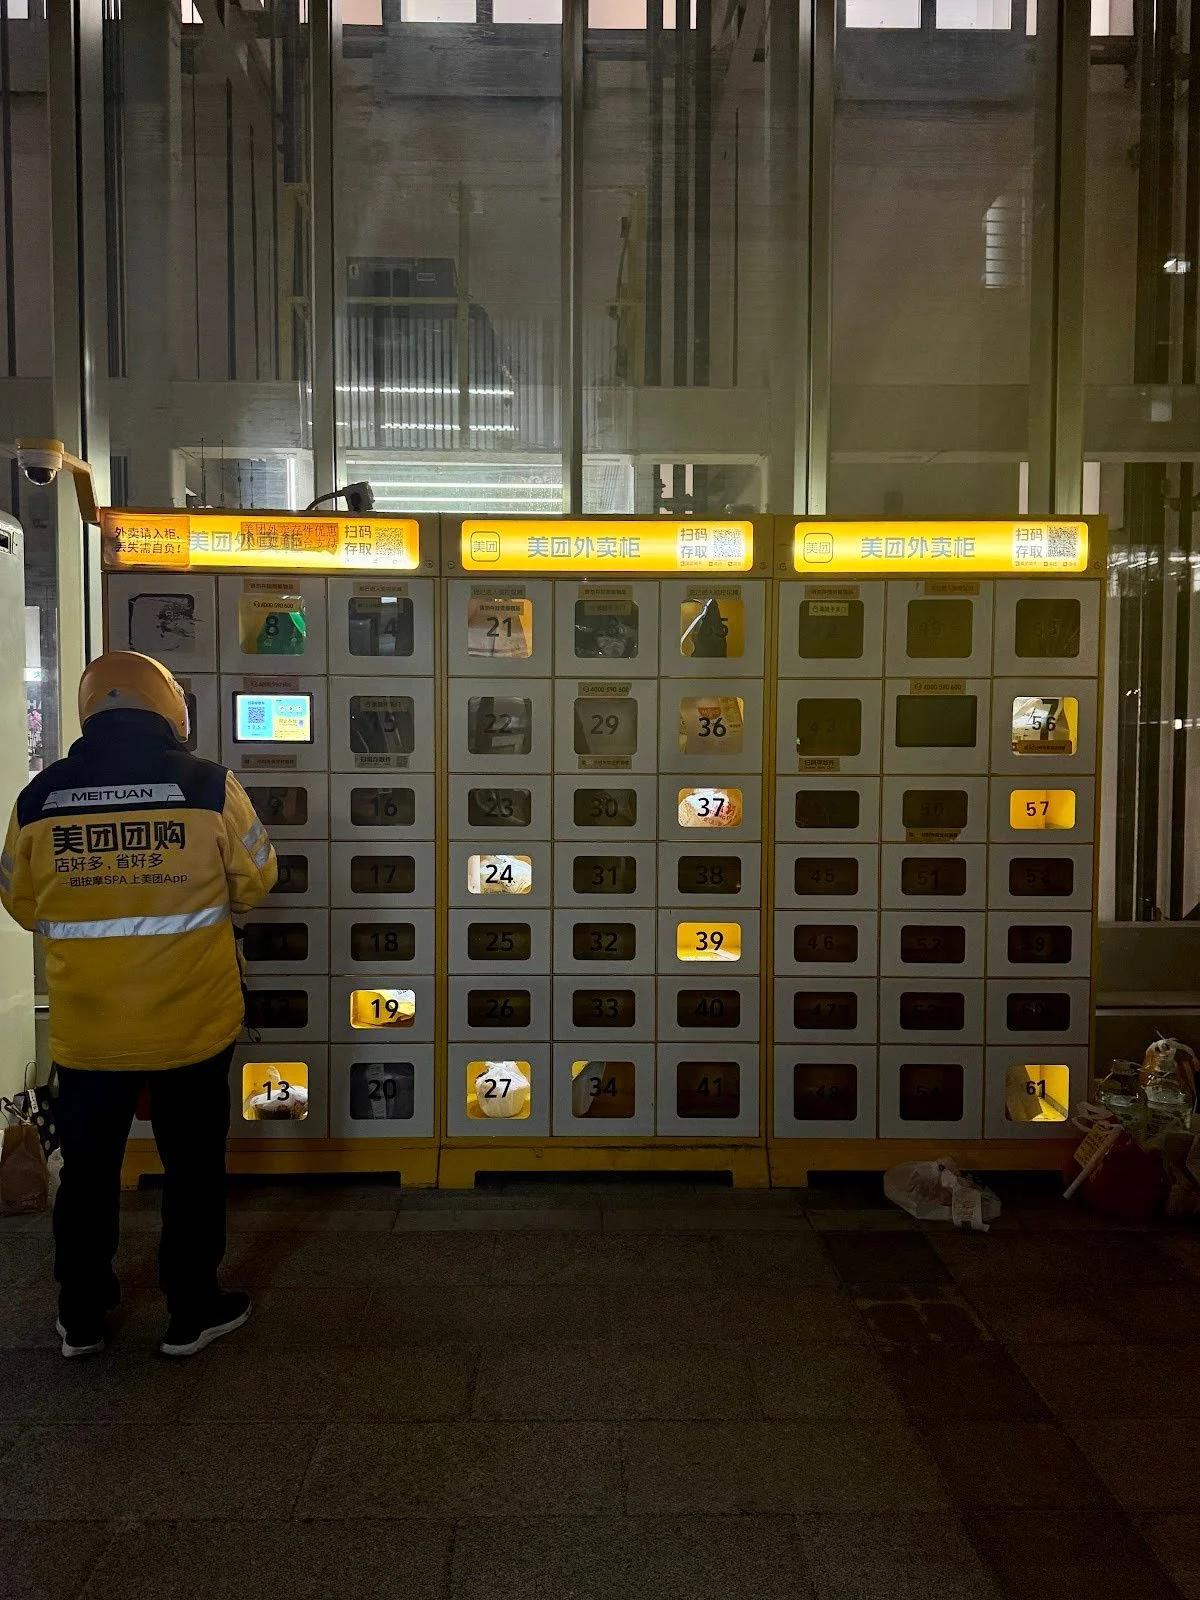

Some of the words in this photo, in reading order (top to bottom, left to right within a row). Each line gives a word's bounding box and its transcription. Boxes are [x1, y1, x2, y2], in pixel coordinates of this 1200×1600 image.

[344, 525, 372, 539] 扫码
[680, 528, 708, 542] 扫码
[1016, 528, 1043, 542] 扫码
[344, 542, 372, 556] 存取
[473, 541, 498, 553] 美团
[527, 536, 641, 559] 美团外卖柜
[680, 545, 708, 559] 存取
[806, 541, 831, 555] 美团
[861, 536, 976, 559] 美团外卖柜
[1016, 545, 1043, 559] 存取
[265, 614, 279, 636] 8
[486, 617, 512, 637] 21
[483, 714, 512, 734] 22
[590, 714, 619, 735] 29
[698, 717, 727, 738] 36
[1032, 715, 1056, 731] 56
[71, 788, 153, 802] MEITUAN
[371, 798, 398, 817] 16
[485, 799, 514, 818] 23
[590, 800, 619, 818] 30
[697, 798, 726, 817] 37
[1026, 801, 1049, 817] 57
[52, 820, 186, 856] 美团团购
[55, 853, 164, 873] 店好多，省好多
[371, 864, 397, 885] 17
[485, 864, 514, 884] 24
[591, 866, 618, 885] 31
[695, 866, 724, 885] 38
[371, 932, 399, 952] 18
[485, 932, 514, 951] 25
[590, 932, 619, 951] 32
[695, 931, 724, 950] 39
[808, 935, 834, 951] 46
[371, 999, 399, 1019] 19
[485, 999, 514, 1018] 26
[591, 998, 619, 1018] 33
[694, 998, 724, 1018] 40
[262, 1081, 290, 1101] 13
[367, 1079, 397, 1100] 20
[484, 1078, 512, 1098] 27
[589, 1077, 618, 1097] 34
[696, 1077, 723, 1097] 41
[1026, 1079, 1047, 1099] 61
